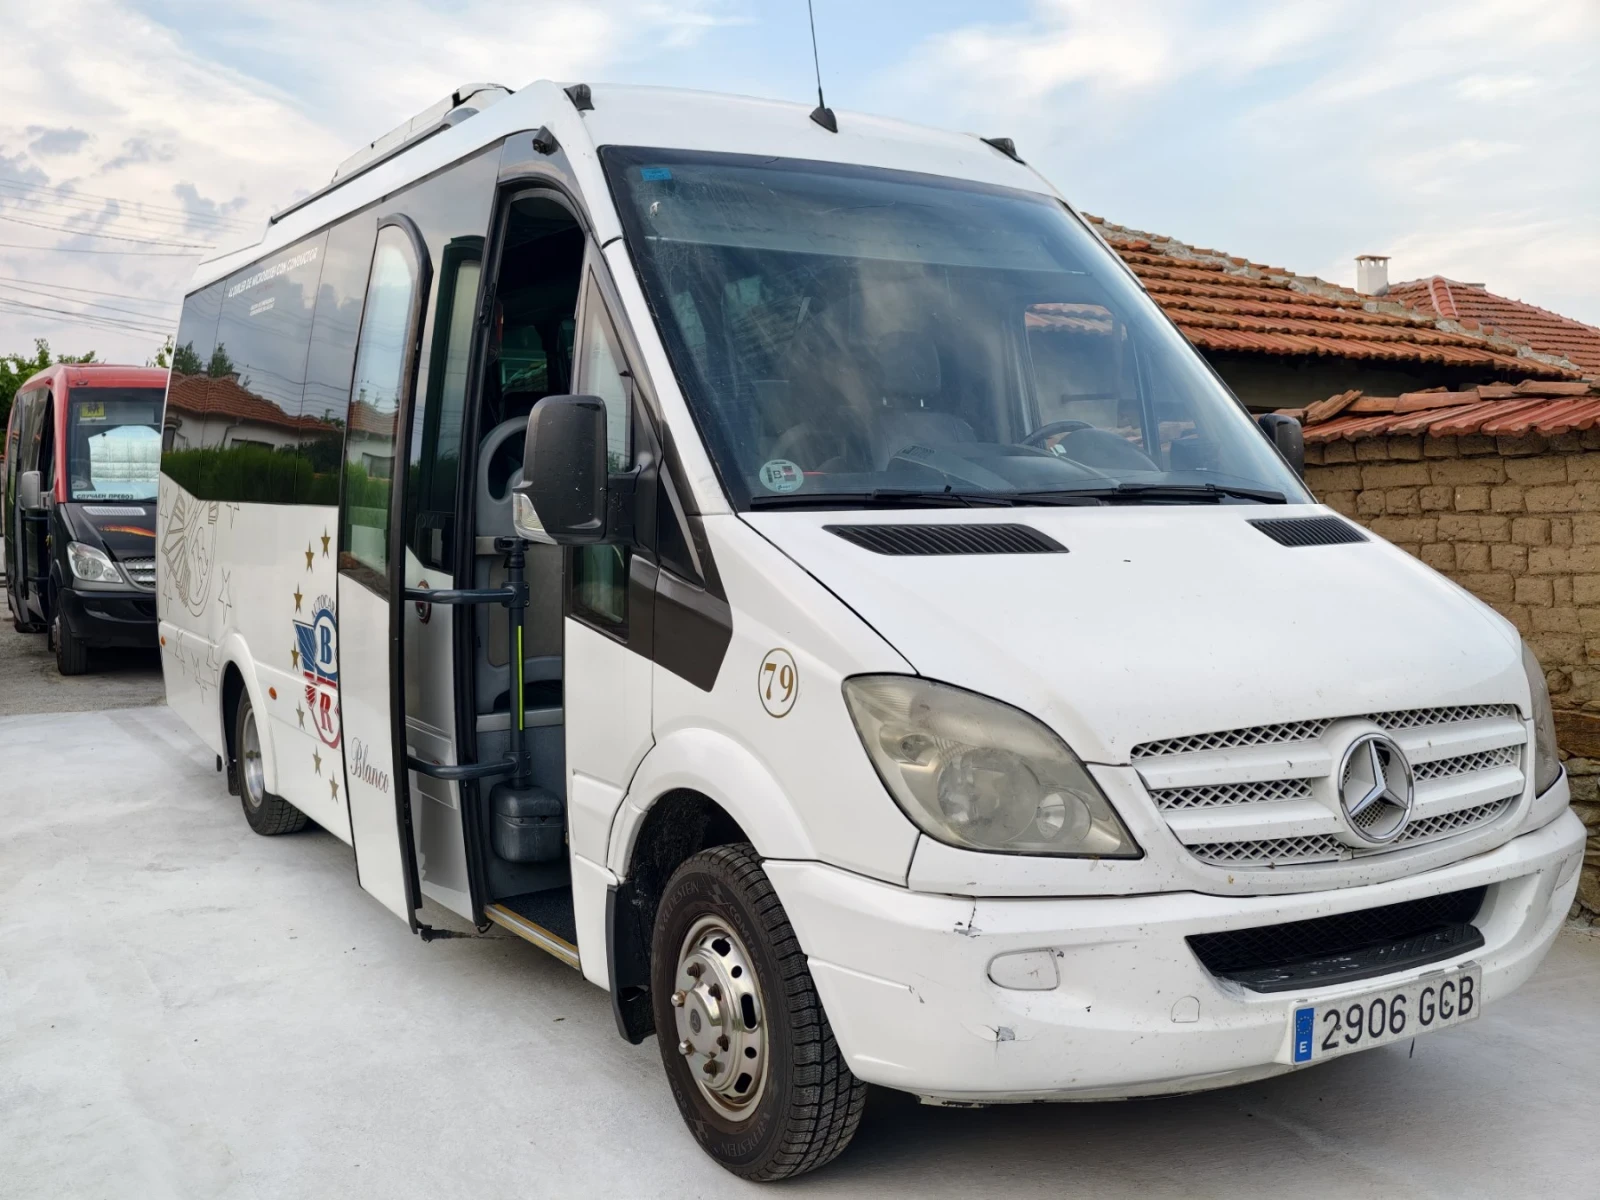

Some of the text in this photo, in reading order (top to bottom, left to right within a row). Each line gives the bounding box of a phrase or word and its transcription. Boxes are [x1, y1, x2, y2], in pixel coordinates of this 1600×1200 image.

[319, 624, 332, 664] B
[763, 662, 794, 703] 79
[320, 692, 334, 734] R
[350, 737, 389, 794] Blanco
[1321, 975, 1475, 1051] 2906 GCB
[1299, 1041, 1308, 1053] E
